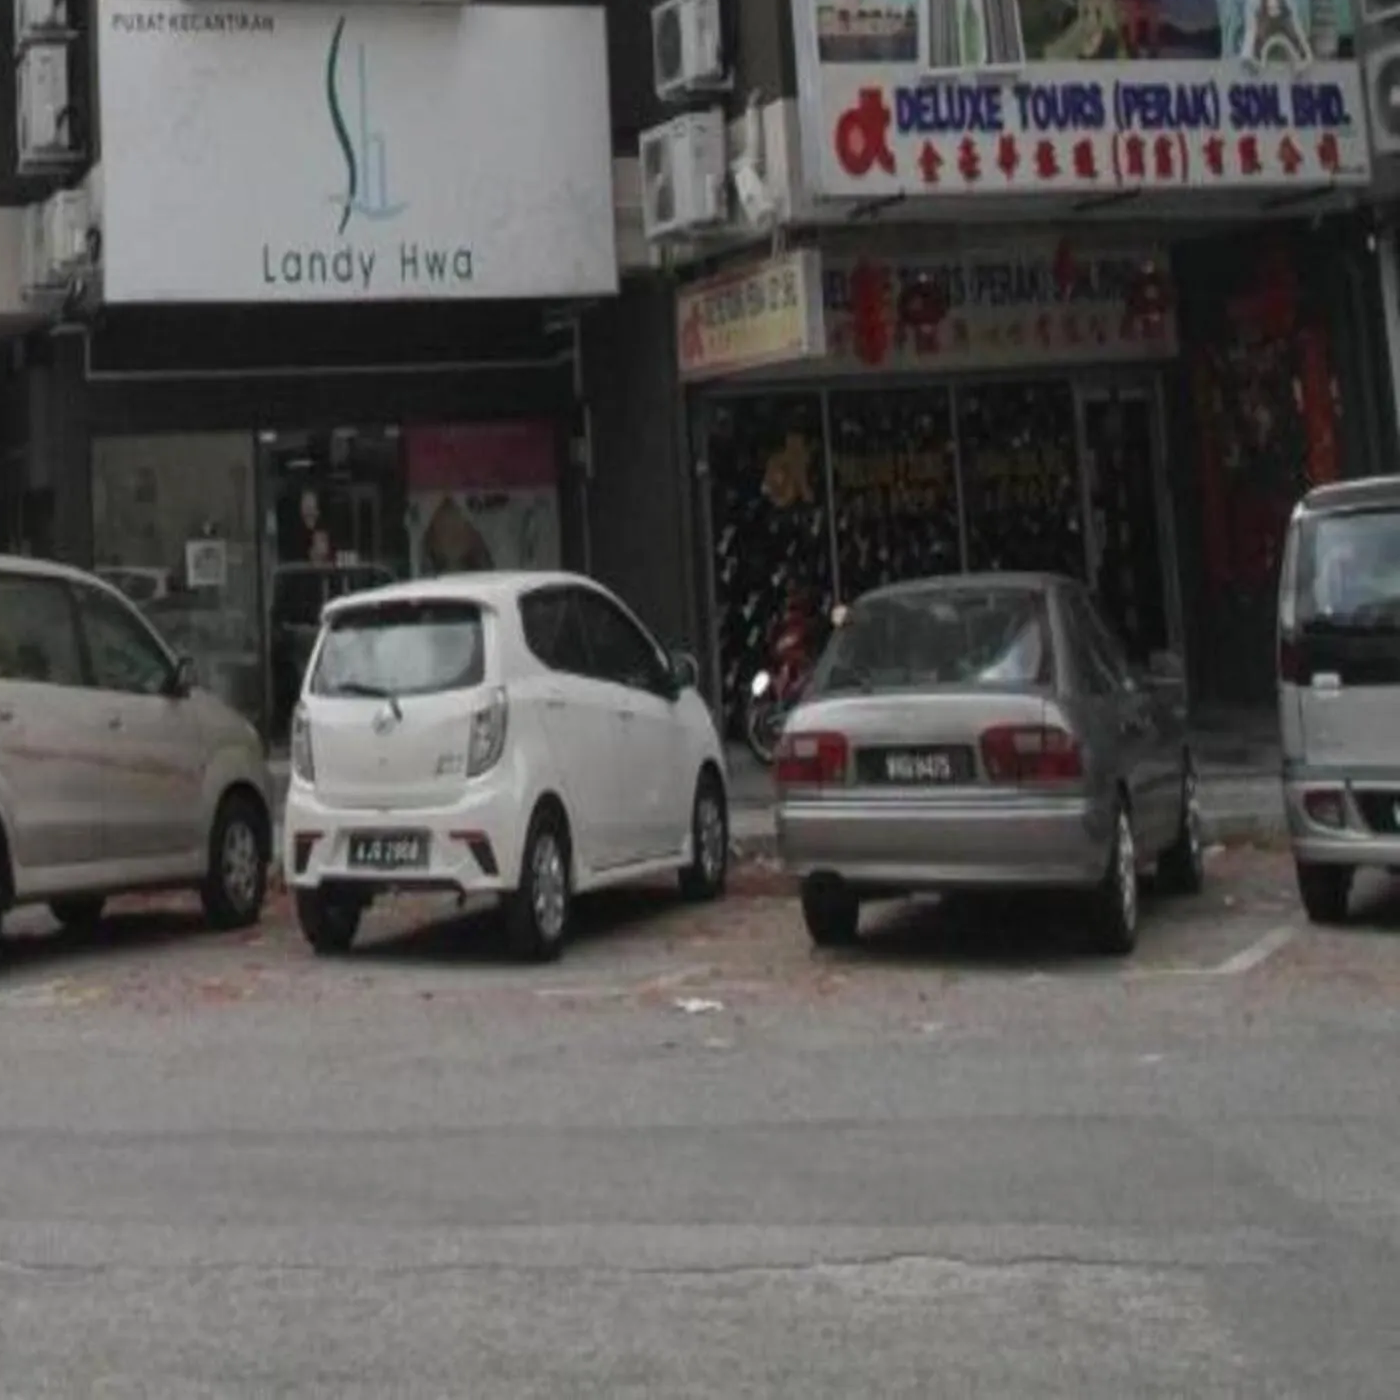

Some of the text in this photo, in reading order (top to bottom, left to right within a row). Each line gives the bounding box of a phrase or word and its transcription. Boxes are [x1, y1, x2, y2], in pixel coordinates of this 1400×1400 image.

[895, 84, 1003, 132] DELUXE
[1014, 81, 1105, 131] TOURS
[1113, 79, 1221, 133] (PERAK)
[262, 243, 473, 290] Landy Hwa
